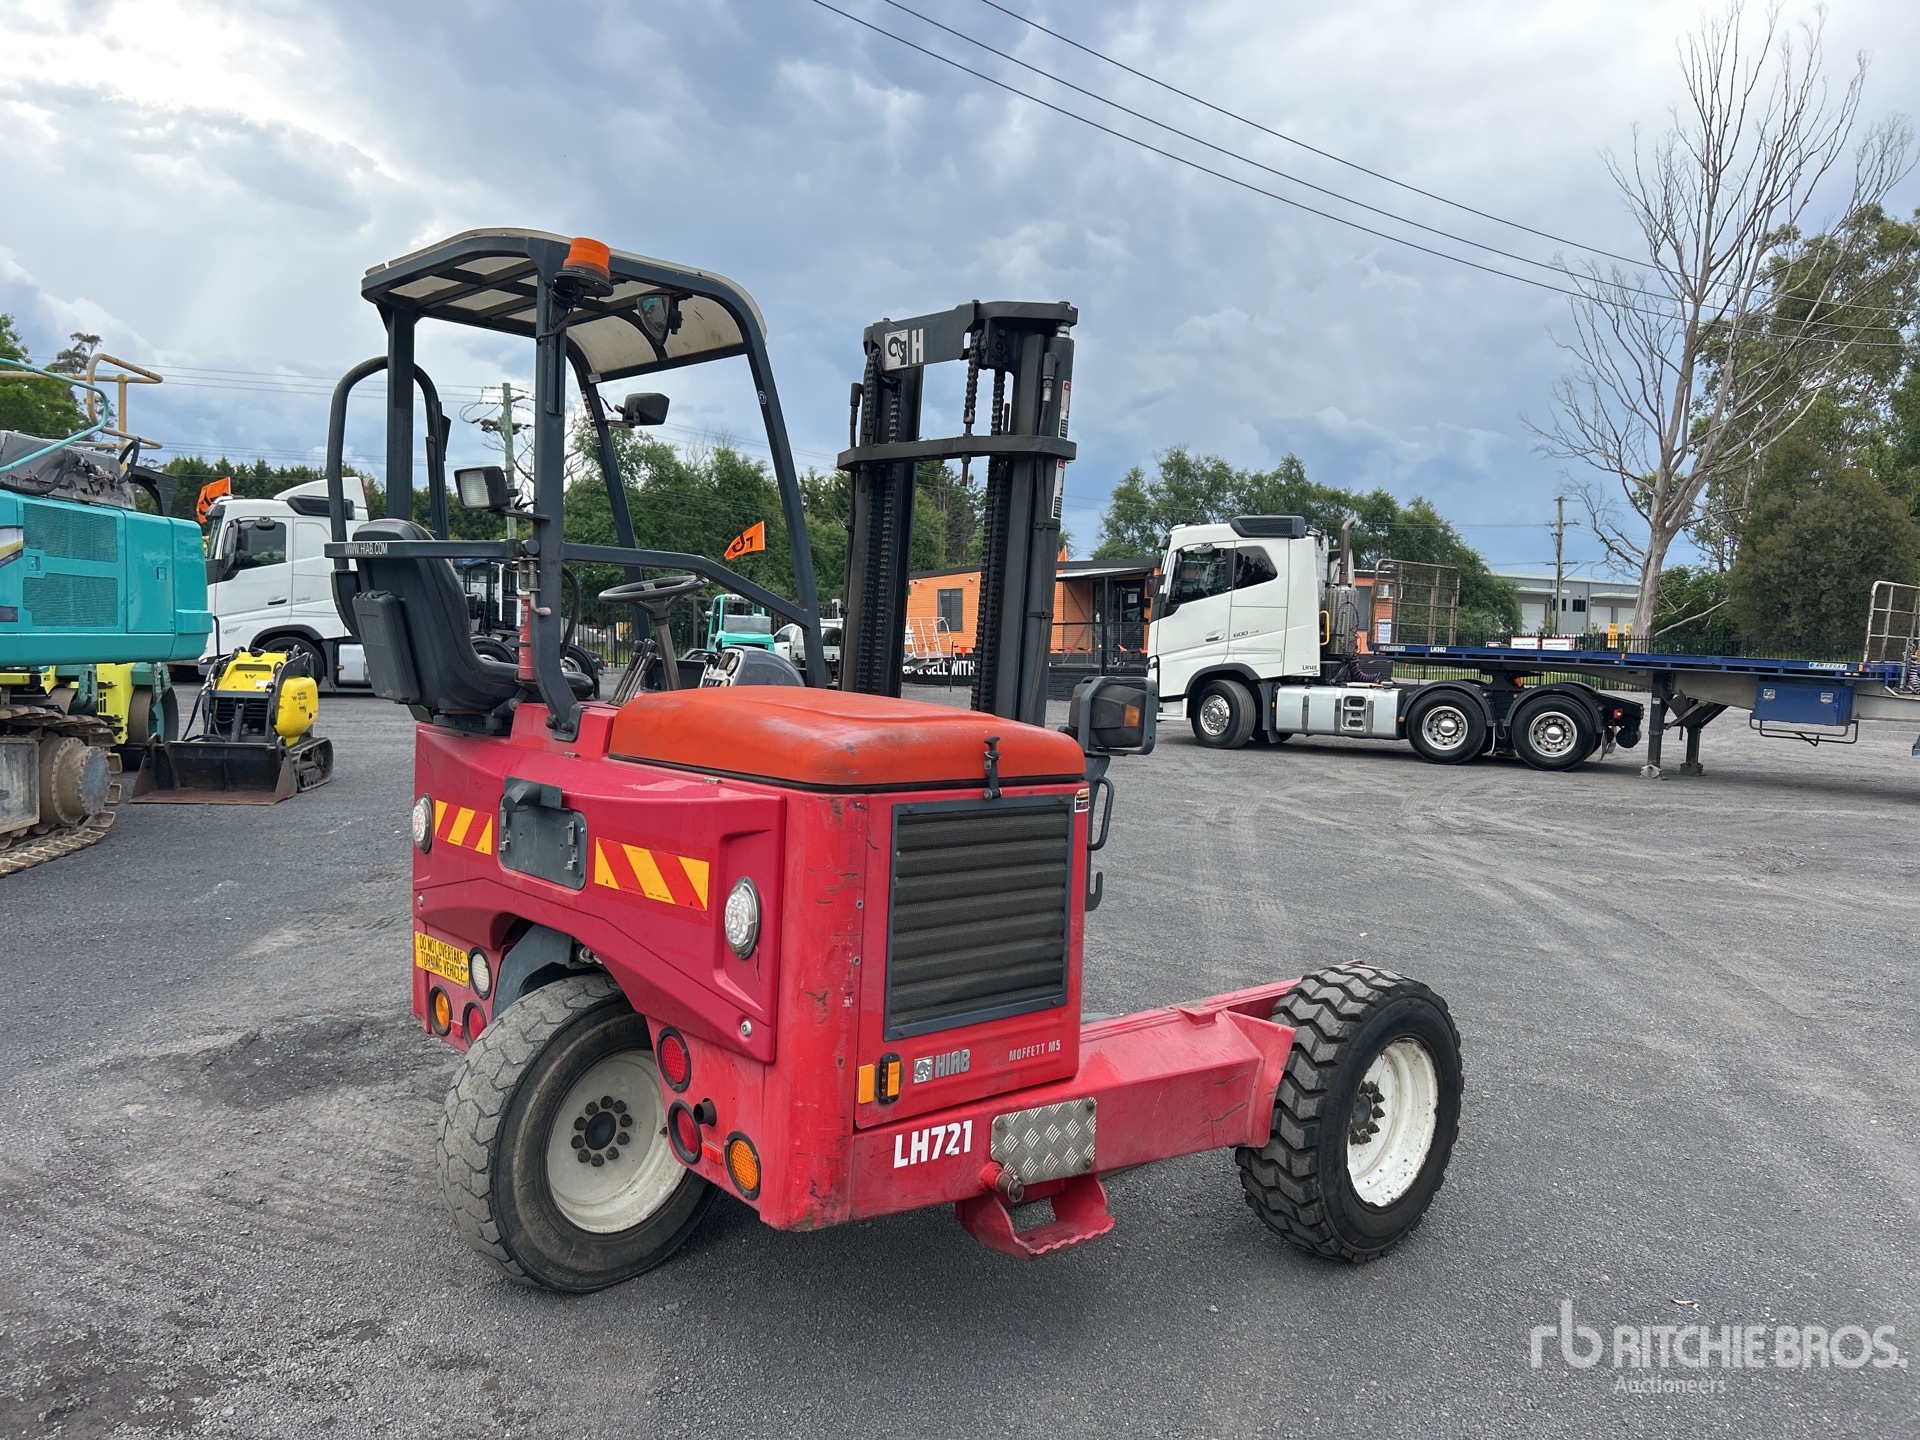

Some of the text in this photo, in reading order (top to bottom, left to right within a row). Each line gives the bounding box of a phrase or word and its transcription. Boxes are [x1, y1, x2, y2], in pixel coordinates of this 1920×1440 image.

[344, 542, 388, 555] WWW.HIAB.COM
[420, 934, 463, 962] DO NOT OVERTAKE
[421, 950, 464, 981] TURNING VEHICLE
[934, 1049, 971, 1079] HIAB
[1008, 1039, 1061, 1061] MOFFETT M5
[893, 1119, 973, 1169] LH721
